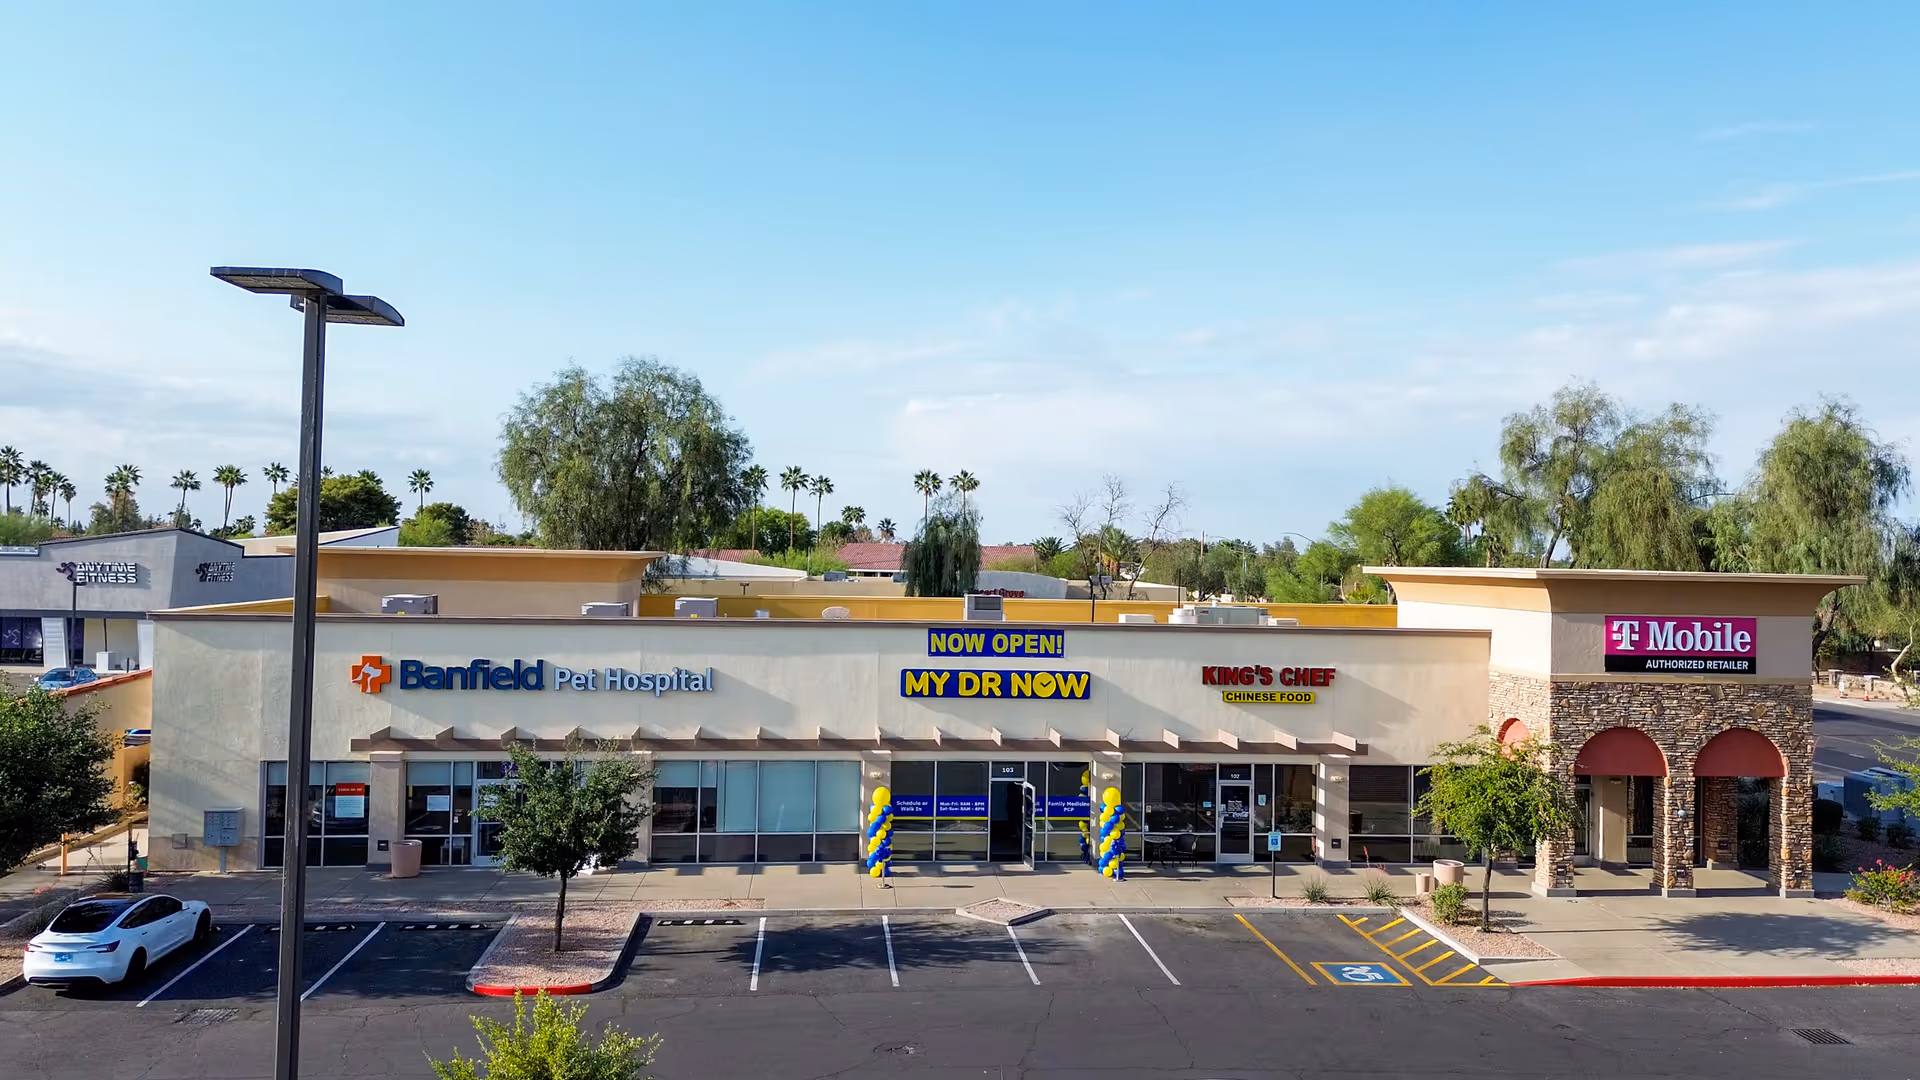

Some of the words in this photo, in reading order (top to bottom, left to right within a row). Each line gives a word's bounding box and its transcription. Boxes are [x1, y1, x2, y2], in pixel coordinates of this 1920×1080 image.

[76, 562, 136, 572] ANYTIME
[76, 573, 137, 584] FITNESS
[930, 633, 985, 653] NOW
[992, 634, 1063, 654] OPEN!
[1646, 621, 1751, 653] Mobile
[1645, 659, 1705, 669] AUTHORIZED
[1706, 660, 1749, 670] RETAILER
[399, 659, 545, 691] Banfield
[554, 667, 597, 691] Pet
[604, 667, 713, 697] Hospital
[905, 671, 950, 696] MY
[958, 671, 1002, 697] DR
[1010, 671, 1089, 698] NOW
[1202, 665, 1274, 686] KING'S
[1280, 667, 1336, 687] CHEF
[1225, 692, 1277, 701] CHINESE
[1280, 693, 1312, 702] FOOD
